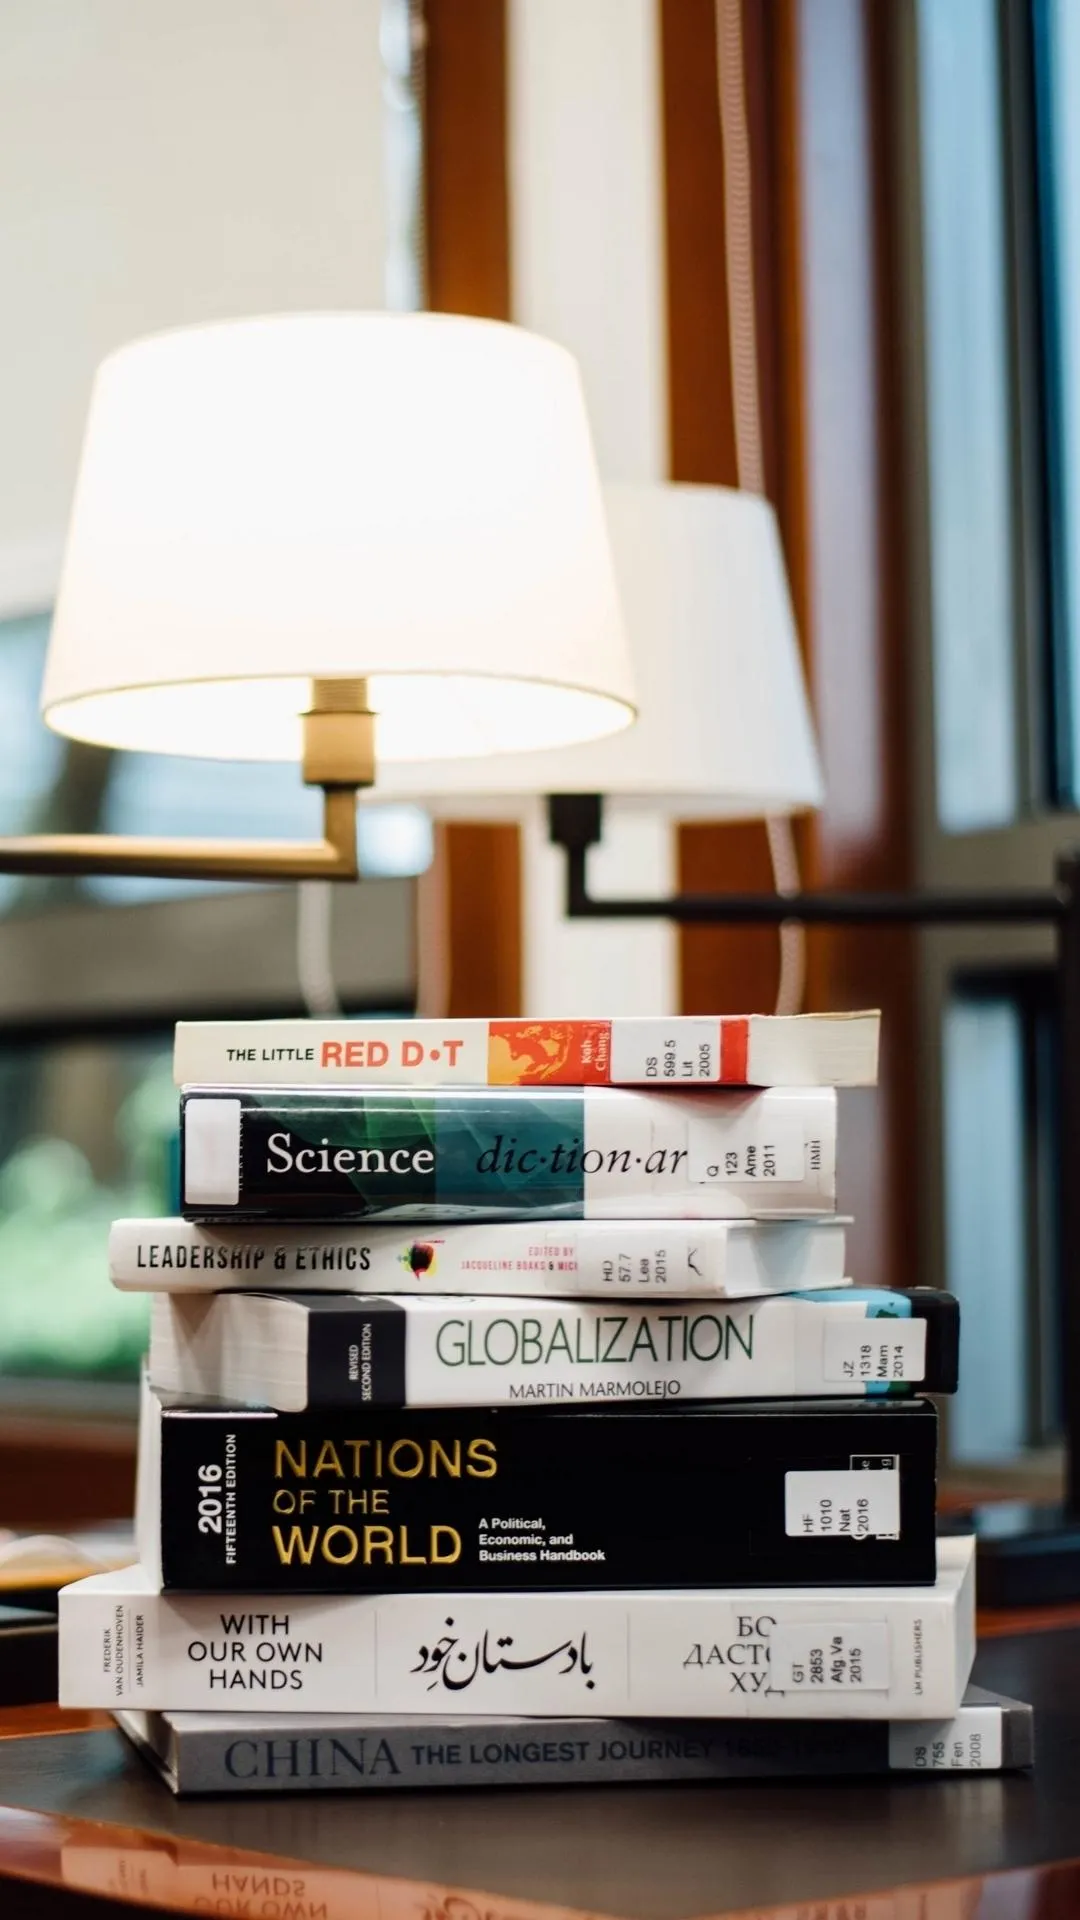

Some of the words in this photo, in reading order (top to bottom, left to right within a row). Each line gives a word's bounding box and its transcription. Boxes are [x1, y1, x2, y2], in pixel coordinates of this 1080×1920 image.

[226, 1048, 257, 1061] THE
[262, 1048, 315, 1061] LITTLE
[320, 1041, 389, 1067] RED
[645, 1057, 658, 1077] DS
[682, 1061, 693, 1077] Lit
[699, 1043, 711, 1077] 2005
[266, 1132, 435, 1174] Science
[725, 1152, 738, 1176] 123
[744, 1145, 757, 1177] Ame
[763, 1144, 775, 1176] 2011
[810, 1139, 821, 1170] HMH
[706, 1165, 719, 1177] Q
[136, 1244, 265, 1270] LEADERSHIP
[273, 1246, 285, 1269] &
[296, 1246, 371, 1270] ETHICS
[461, 1260, 513, 1271] JACQUELINE
[516, 1260, 546, 1271] BOAKS
[528, 1246, 560, 1257] EDITED
[563, 1246, 574, 1257] BY
[655, 1249, 666, 1283] 2015
[619, 1253, 631, 1283] 57.7
[638, 1258, 649, 1283] Lea
[361, 1323, 372, 1361] EDITION
[435, 1314, 754, 1367] GLOBALIZATION
[348, 1344, 359, 1380] REVISED
[843, 1360, 855, 1377] JZ
[860, 1344, 872, 1376] 1318
[876, 1344, 888, 1377] Mam
[893, 1345, 904, 1377] 2014
[361, 1362, 372, 1401] SECOND
[508, 1381, 574, 1399] MARTIN
[579, 1379, 681, 1399] MARMOLEJO
[225, 1433, 237, 1488] EDITION
[274, 1438, 499, 1479] NATIONS
[197, 1463, 223, 1534] 2016
[272, 1489, 317, 1515] OF
[328, 1489, 391, 1515] THE
[225, 1491, 237, 1565] FIFTEENTH
[478, 1517, 489, 1529] A
[491, 1517, 546, 1531] Political,
[819, 1499, 833, 1532] 1010
[838, 1508, 851, 1532] Nat
[856, 1498, 869, 1532] 2016
[271, 1524, 462, 1566] WORLD
[478, 1533, 546, 1547] Economic,
[549, 1533, 574, 1545] and
[478, 1549, 538, 1561] Business
[539, 1549, 606, 1561] Handbook
[115, 1604, 124, 1674] OUDENHOVEN
[135, 1614, 144, 1651] HAIDER
[219, 1614, 290, 1636] WITH
[102, 1628, 112, 1673] FREDERIK
[187, 1641, 247, 1663] OUR
[256, 1642, 323, 1663] OWN
[683, 1643, 771, 1669] ДАСТ
[912, 1618, 923, 1679] PUBLISHERS
[135, 1652, 144, 1688] JAMILA
[208, 1669, 304, 1690] HANDS
[810, 1648, 823, 1684] 2853
[850, 1647, 862, 1683] 2015
[115, 1676, 124, 1697] VAN
[729, 1671, 785, 1698] ХУ
[223, 1737, 402, 1779] CHINA
[410, 1744, 463, 1765] THE
[469, 1741, 591, 1764] LONGEST
[598, 1738, 714, 1761] JOURNEY
[914, 1746, 927, 1768] DS
[932, 1741, 945, 1767] 755
[950, 1741, 964, 1767] Fen
[968, 1733, 982, 1768] 2008
